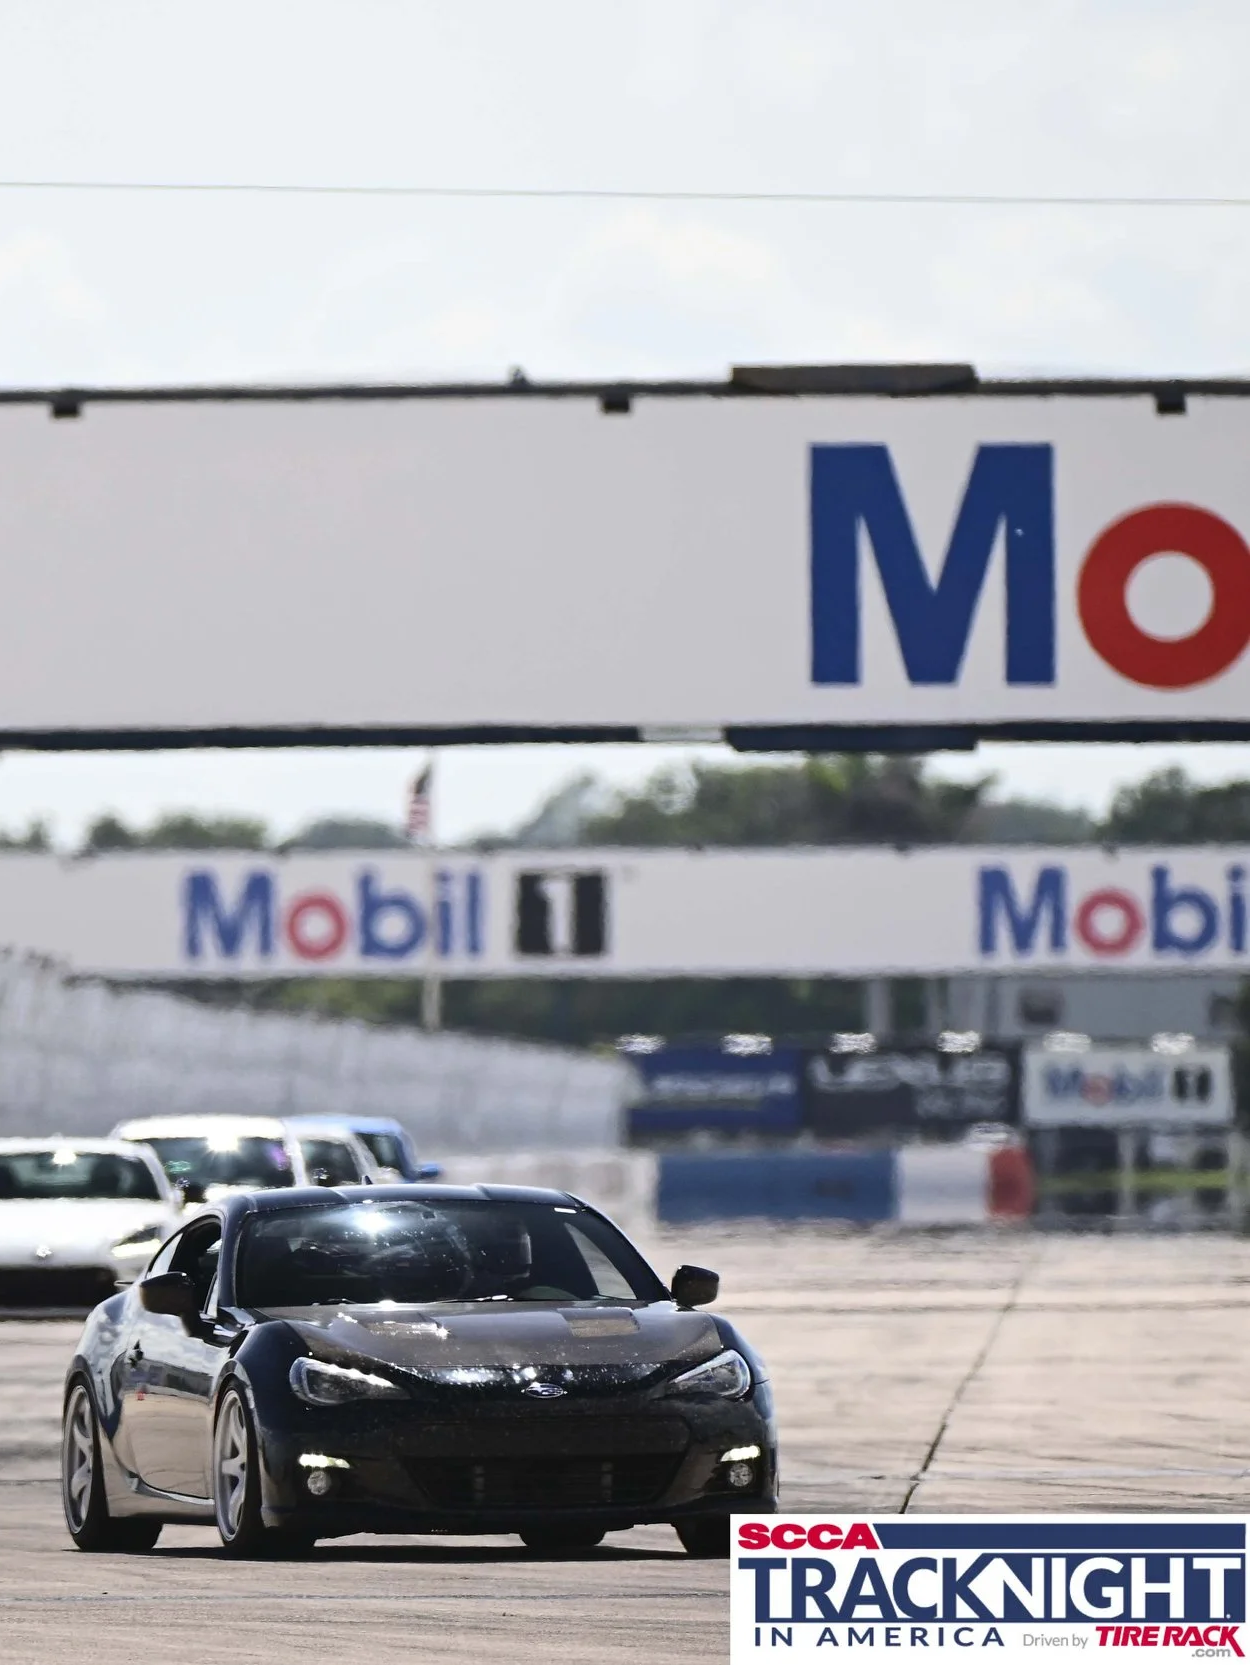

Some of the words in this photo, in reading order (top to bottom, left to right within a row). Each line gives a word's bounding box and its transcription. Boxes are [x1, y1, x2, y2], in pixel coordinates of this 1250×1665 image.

[808, 442, 1250, 691] Mo
[185, 870, 482, 959] Mobil
[978, 865, 1248, 957] Mobi
